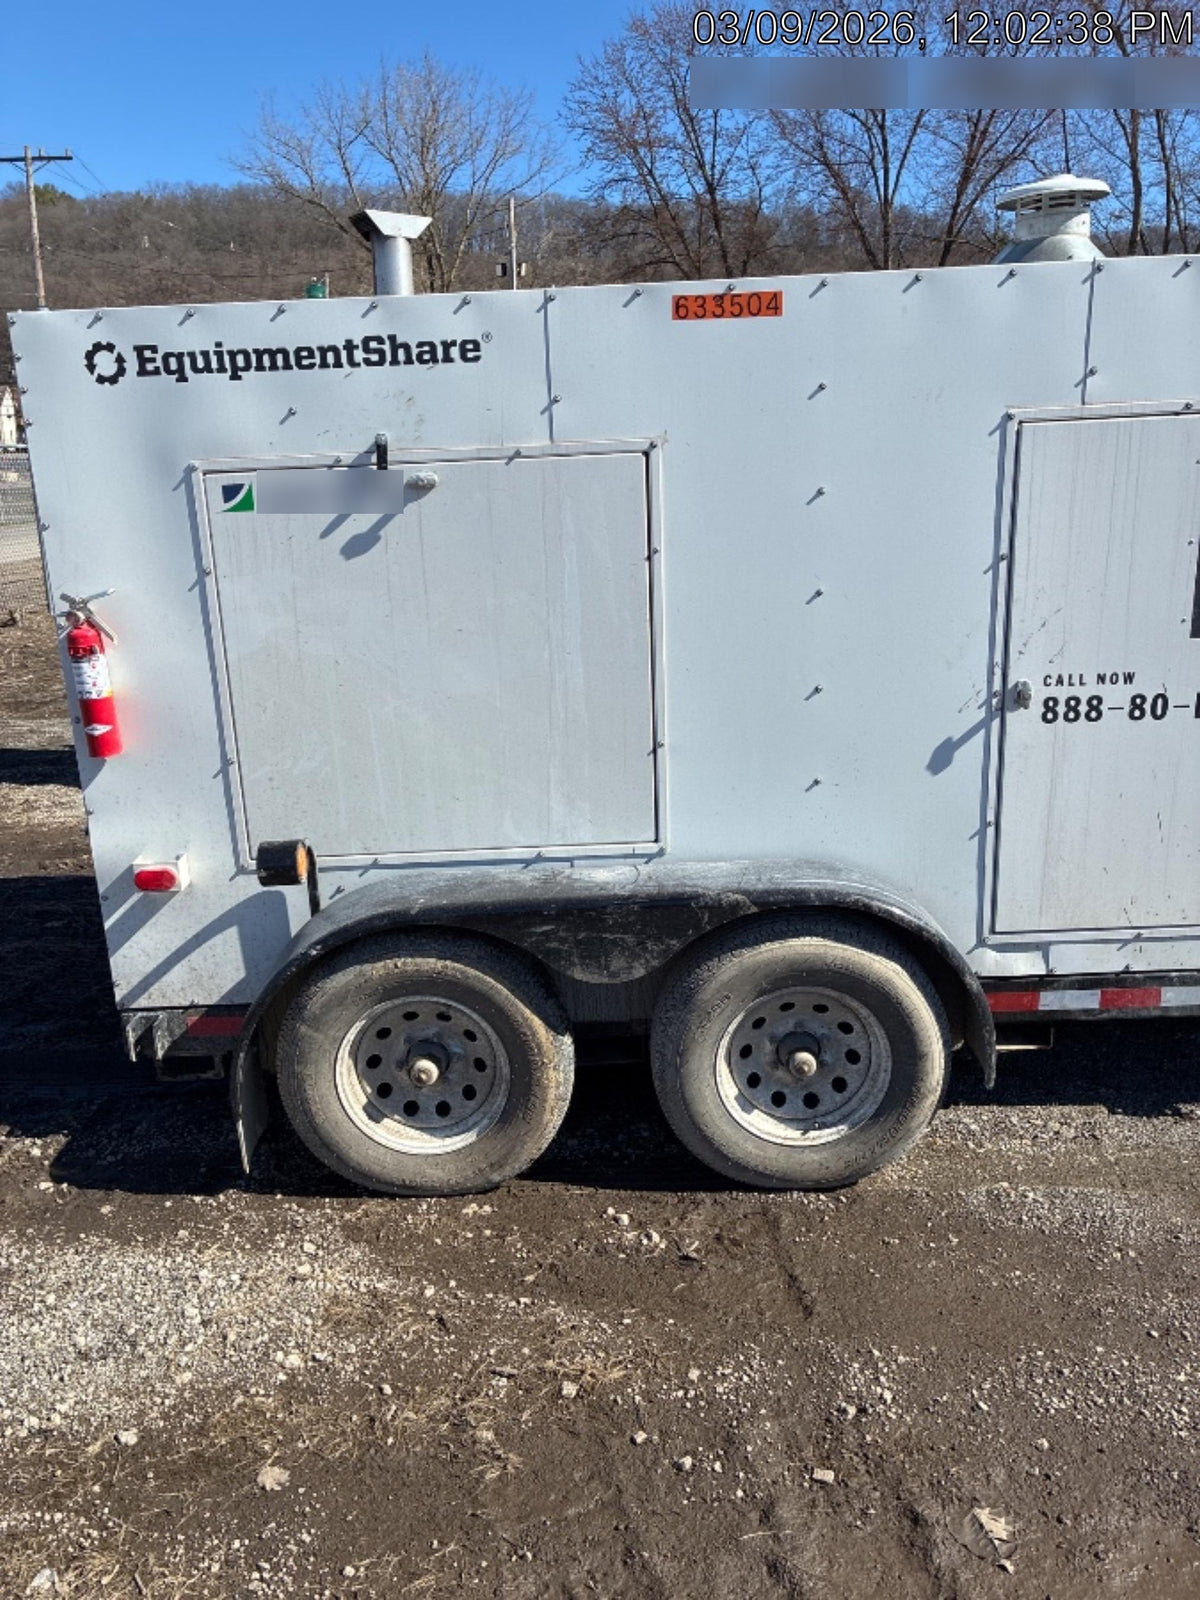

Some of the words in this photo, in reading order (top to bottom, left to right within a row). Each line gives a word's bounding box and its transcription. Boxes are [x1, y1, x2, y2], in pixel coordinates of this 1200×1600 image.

[675, 293, 780, 320] 633504
[1043, 673, 1087, 687] CALL
[1096, 671, 1136, 686] NOW
